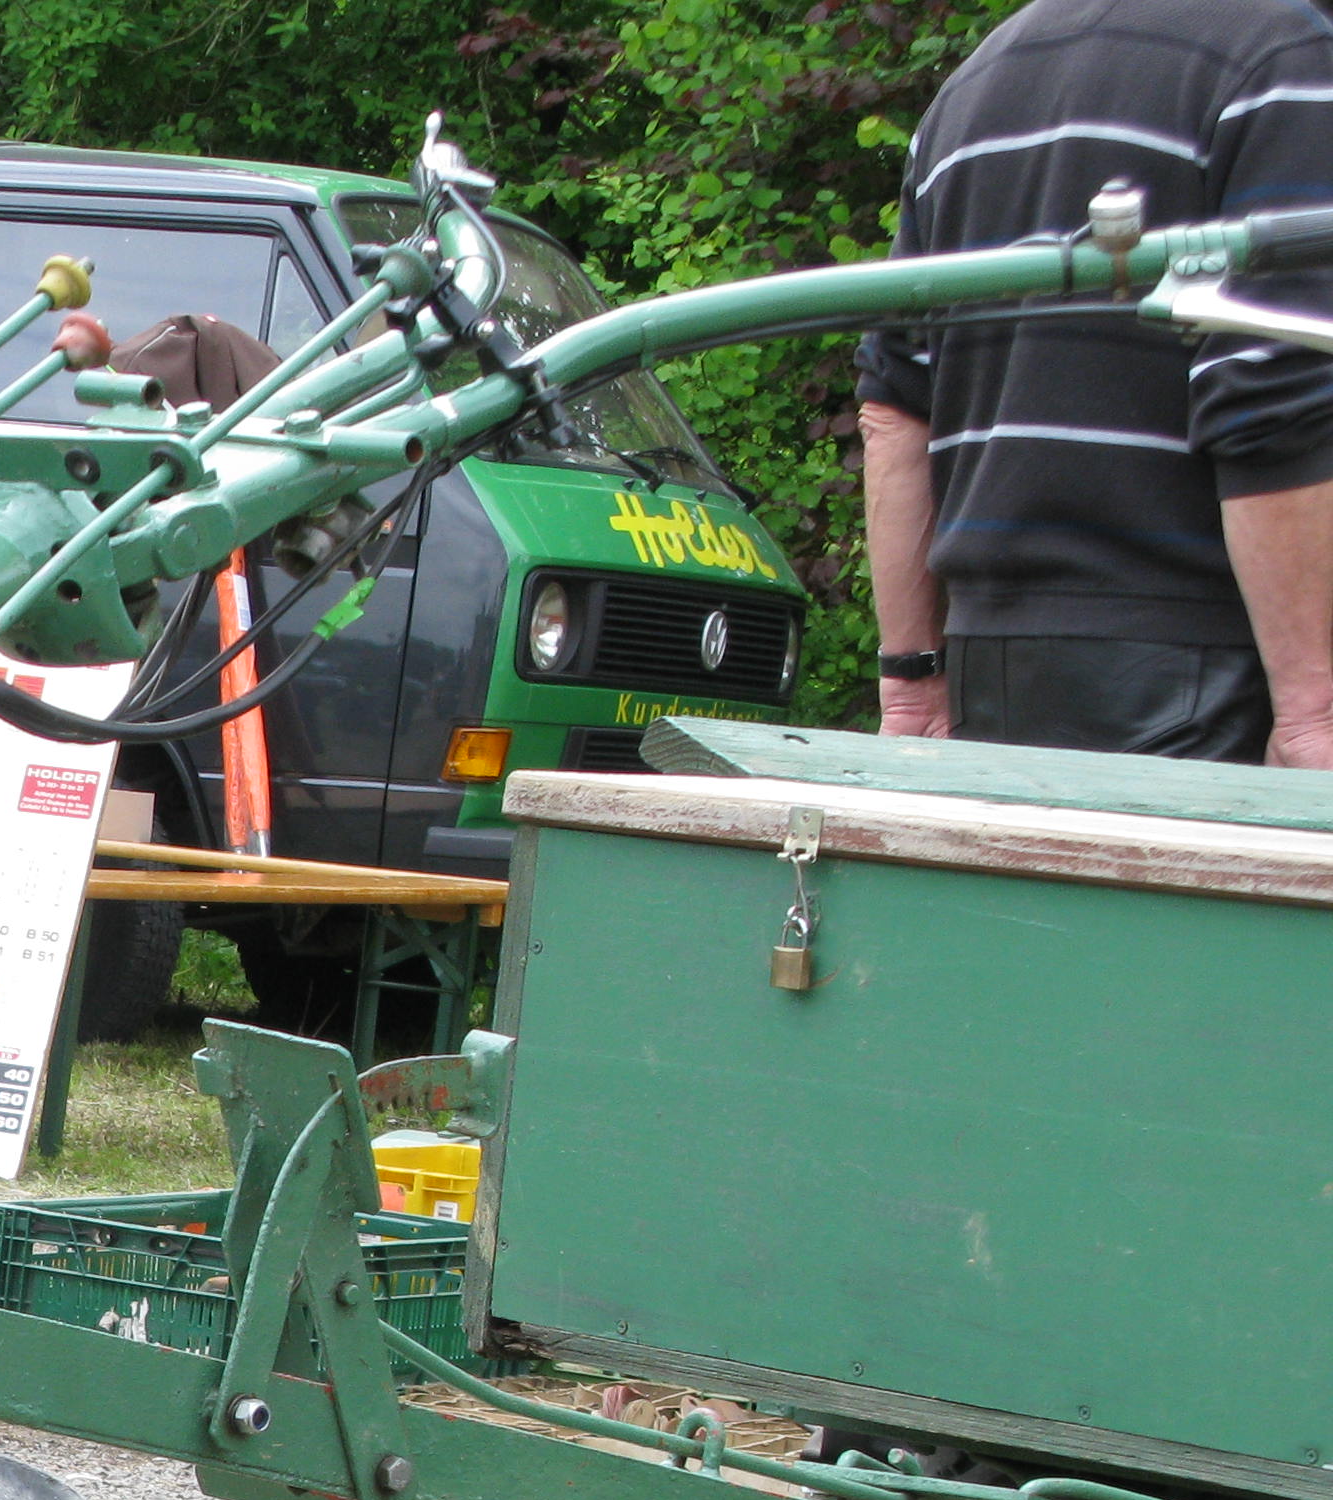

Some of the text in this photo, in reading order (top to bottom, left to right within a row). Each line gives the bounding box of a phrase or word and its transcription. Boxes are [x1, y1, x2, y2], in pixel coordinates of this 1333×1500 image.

[609, 492, 778, 581] Holder
[27, 767, 98, 785] HOLDER
[26, 928, 60, 943] B 50
[22, 949, 56, 963] B 51
[4, 1068, 31, 1083] 40
